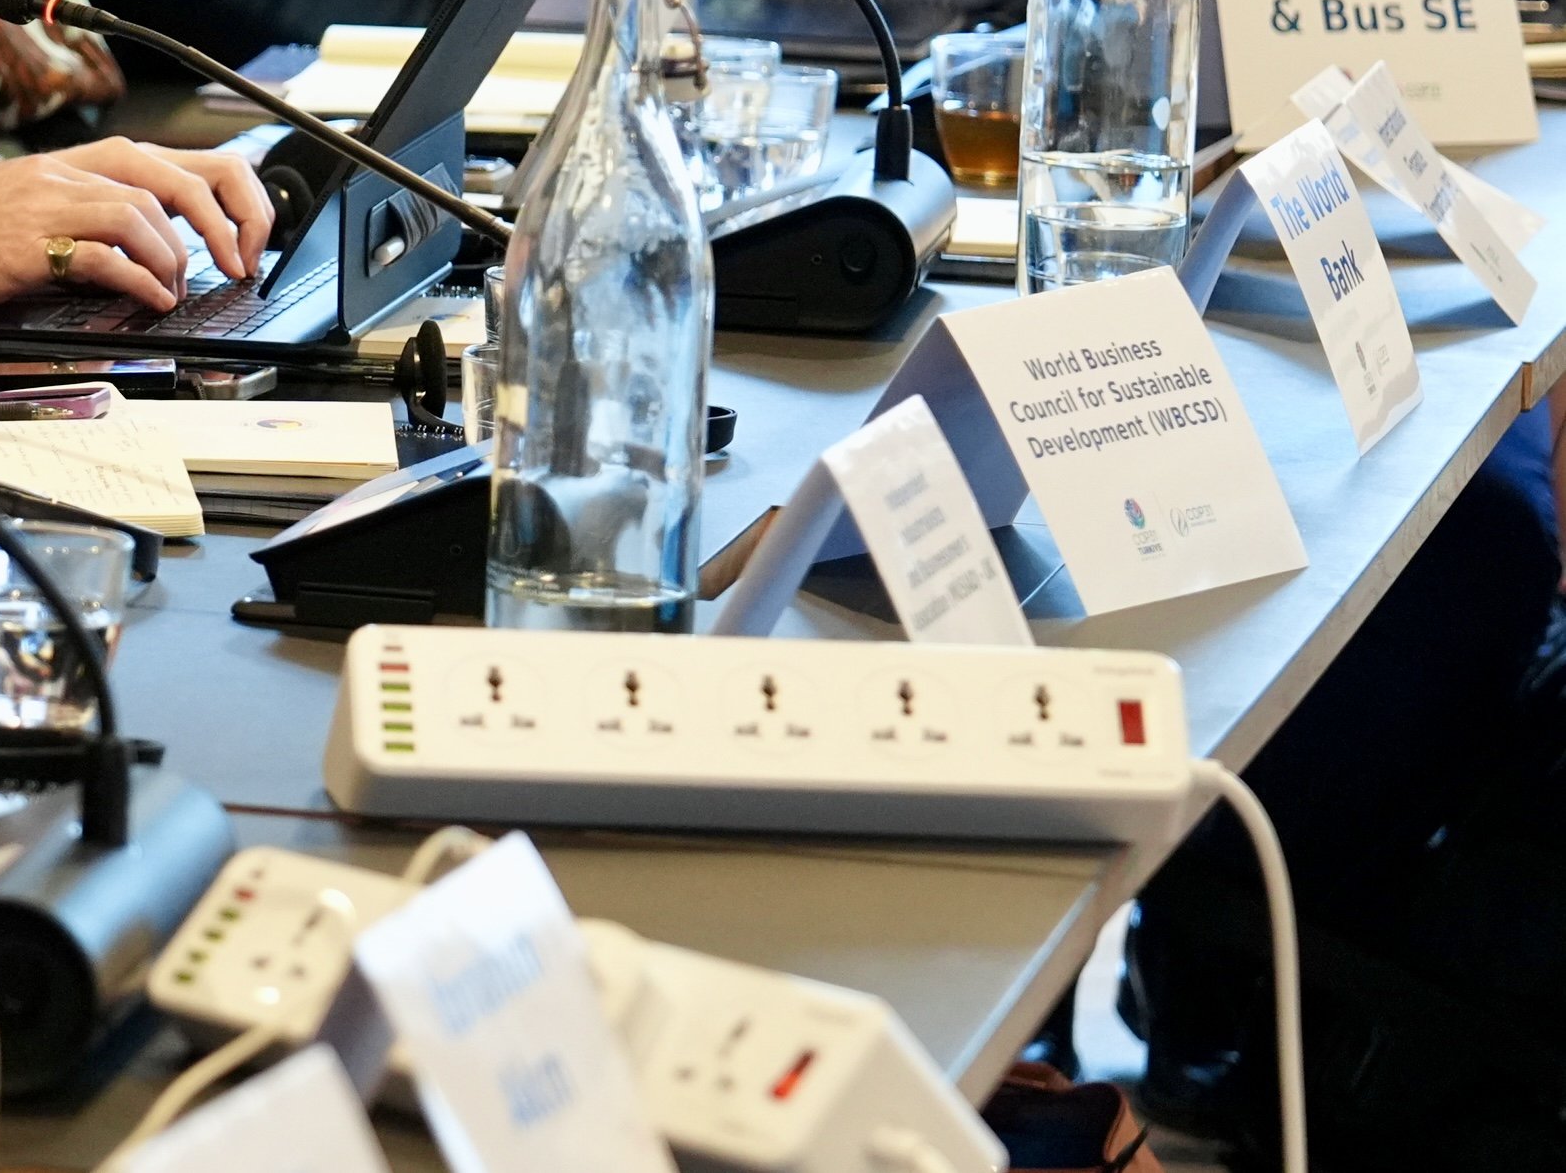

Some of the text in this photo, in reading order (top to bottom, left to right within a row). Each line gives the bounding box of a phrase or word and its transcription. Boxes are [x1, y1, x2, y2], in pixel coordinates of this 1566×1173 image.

[1270, 167, 1350, 240] The World
[1319, 240, 1365, 302] Bank
[1024, 337, 1162, 381] World Business
[1010, 364, 1213, 423] Council for Sustainable
[1027, 397, 1227, 459] Development (WBCSD)
